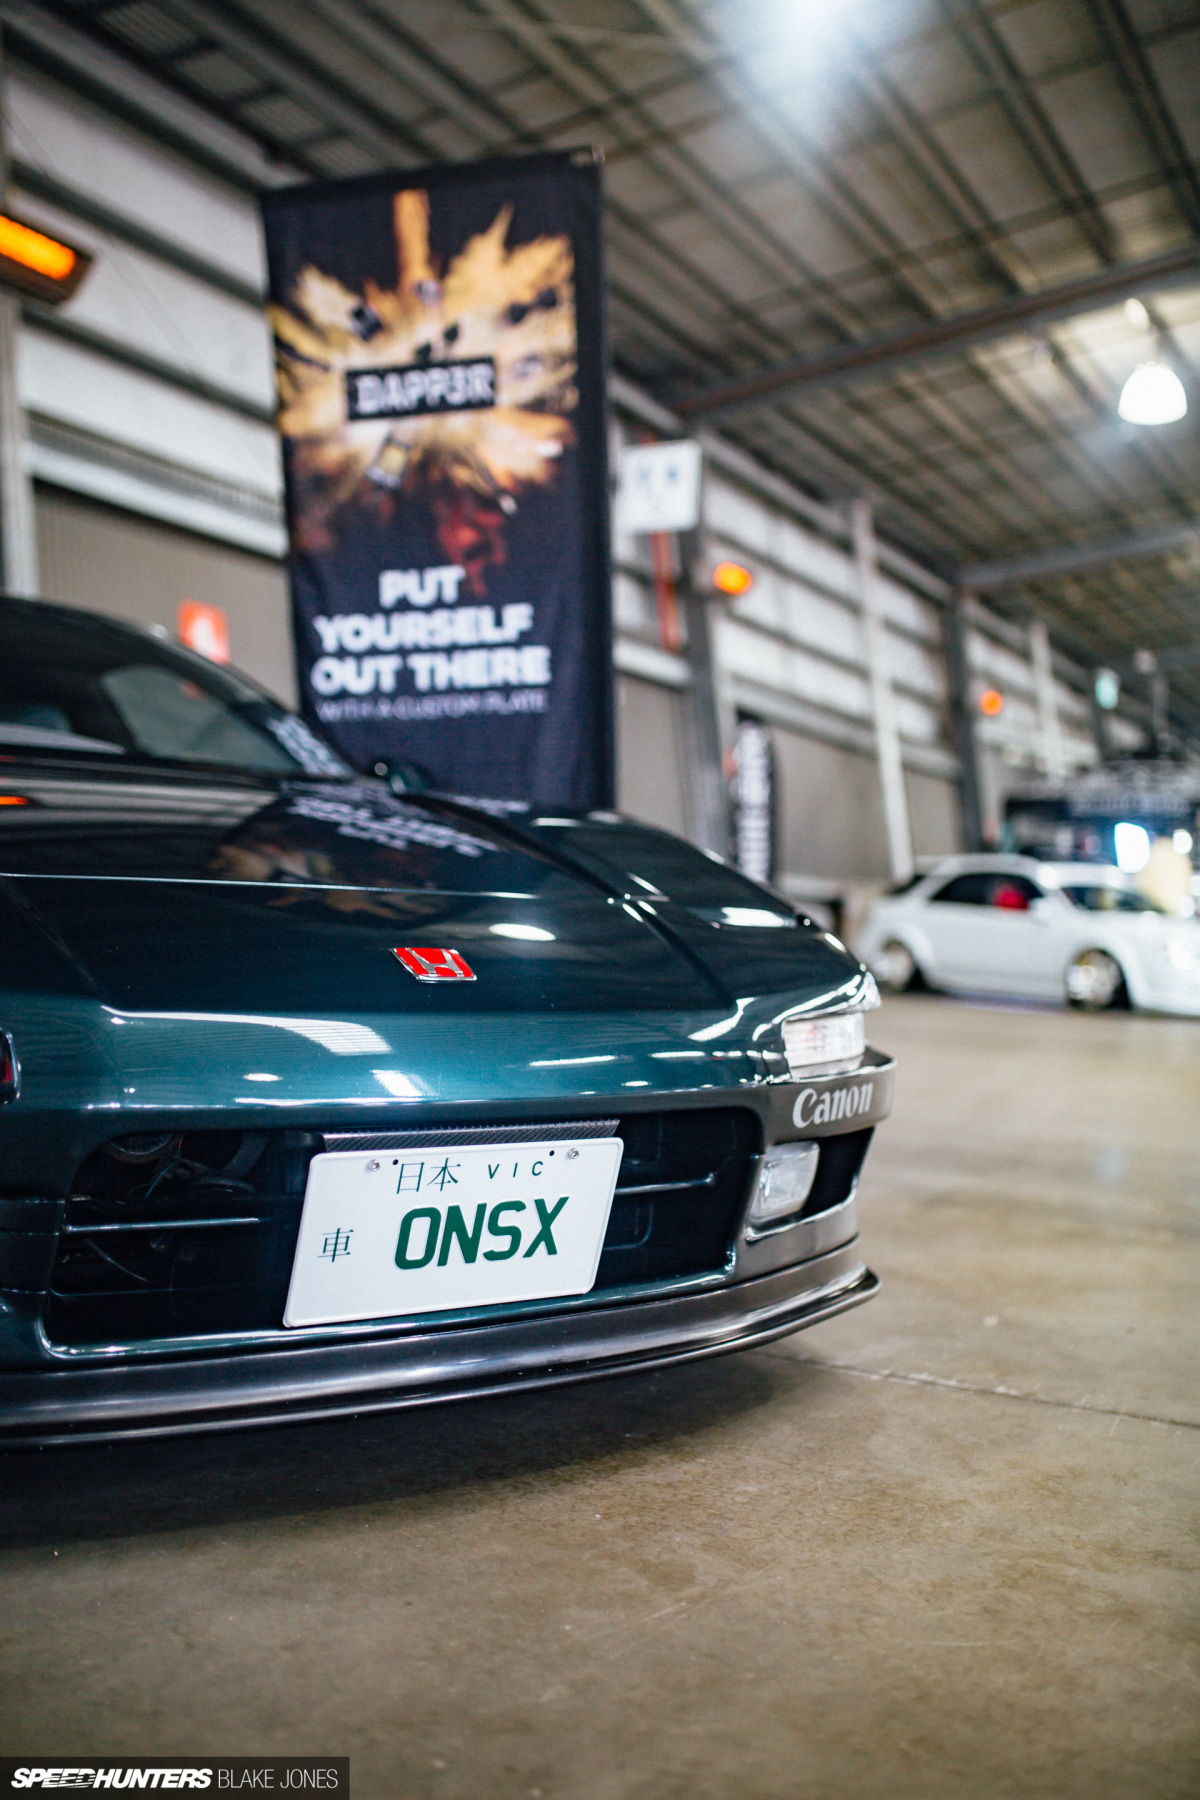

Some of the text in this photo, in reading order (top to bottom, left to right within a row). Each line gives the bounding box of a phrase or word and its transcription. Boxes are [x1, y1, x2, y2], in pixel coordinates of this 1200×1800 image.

[379, 565, 466, 609] PUT
[312, 602, 534, 653] YOURSELF
[311, 645, 552, 696] OUT THERE
[483, 688, 548, 716] PLATE
[792, 1082, 874, 1129] Canon
[396, 1157, 461, 1194] 日本
[317, 1227, 354, 1262] 車
